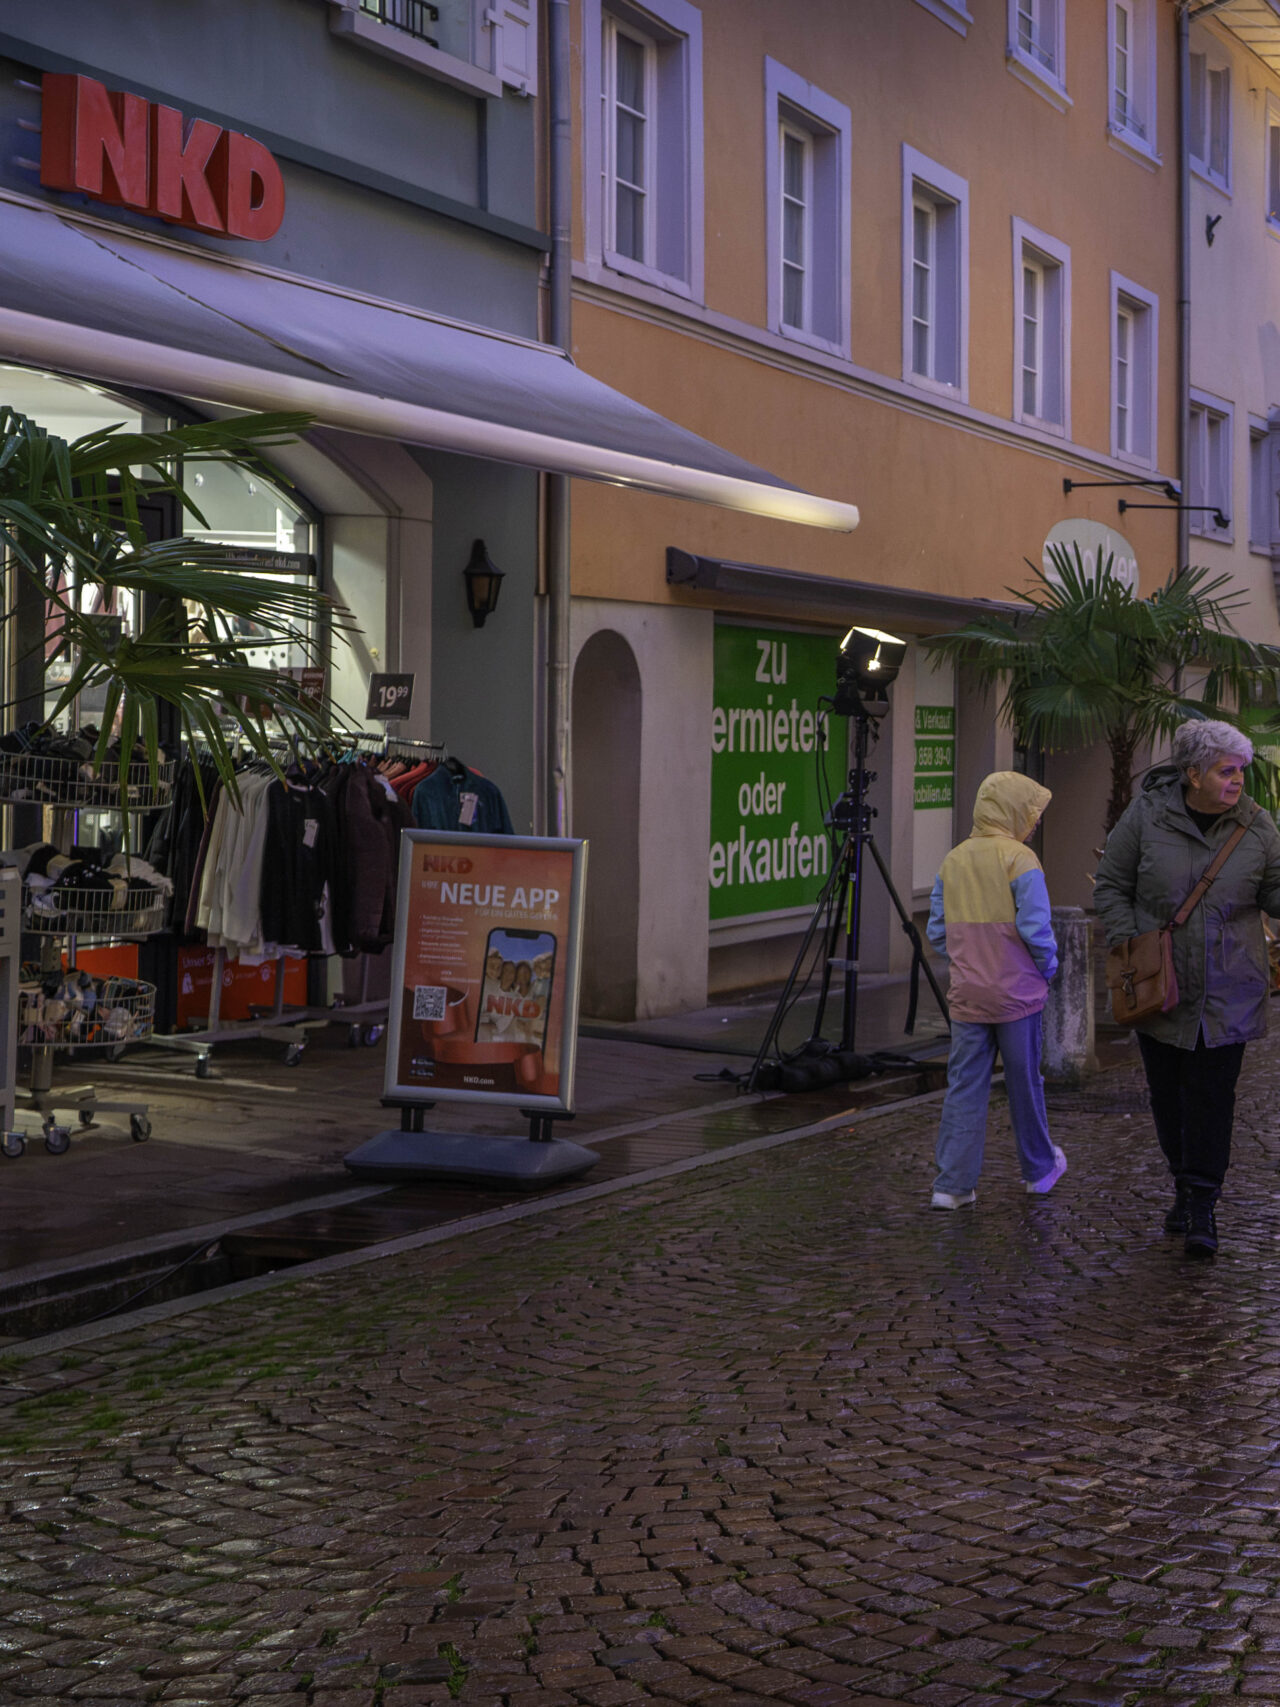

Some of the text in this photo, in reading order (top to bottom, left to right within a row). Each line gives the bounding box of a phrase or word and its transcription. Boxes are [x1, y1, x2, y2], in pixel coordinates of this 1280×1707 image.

[41, 74, 286, 242] NKD
[755, 639, 788, 685] zu
[711, 695, 829, 753] ermieten
[923, 710, 951, 729] Verkauf
[738, 771, 786, 817] oder
[423, 854, 474, 874] NKD
[708, 822, 828, 888] erkaufen
[440, 881, 506, 908] NEUE
[510, 887, 560, 910] APP
[487, 994, 541, 1018] NKD
[463, 1076, 495, 1085] NKD.com
